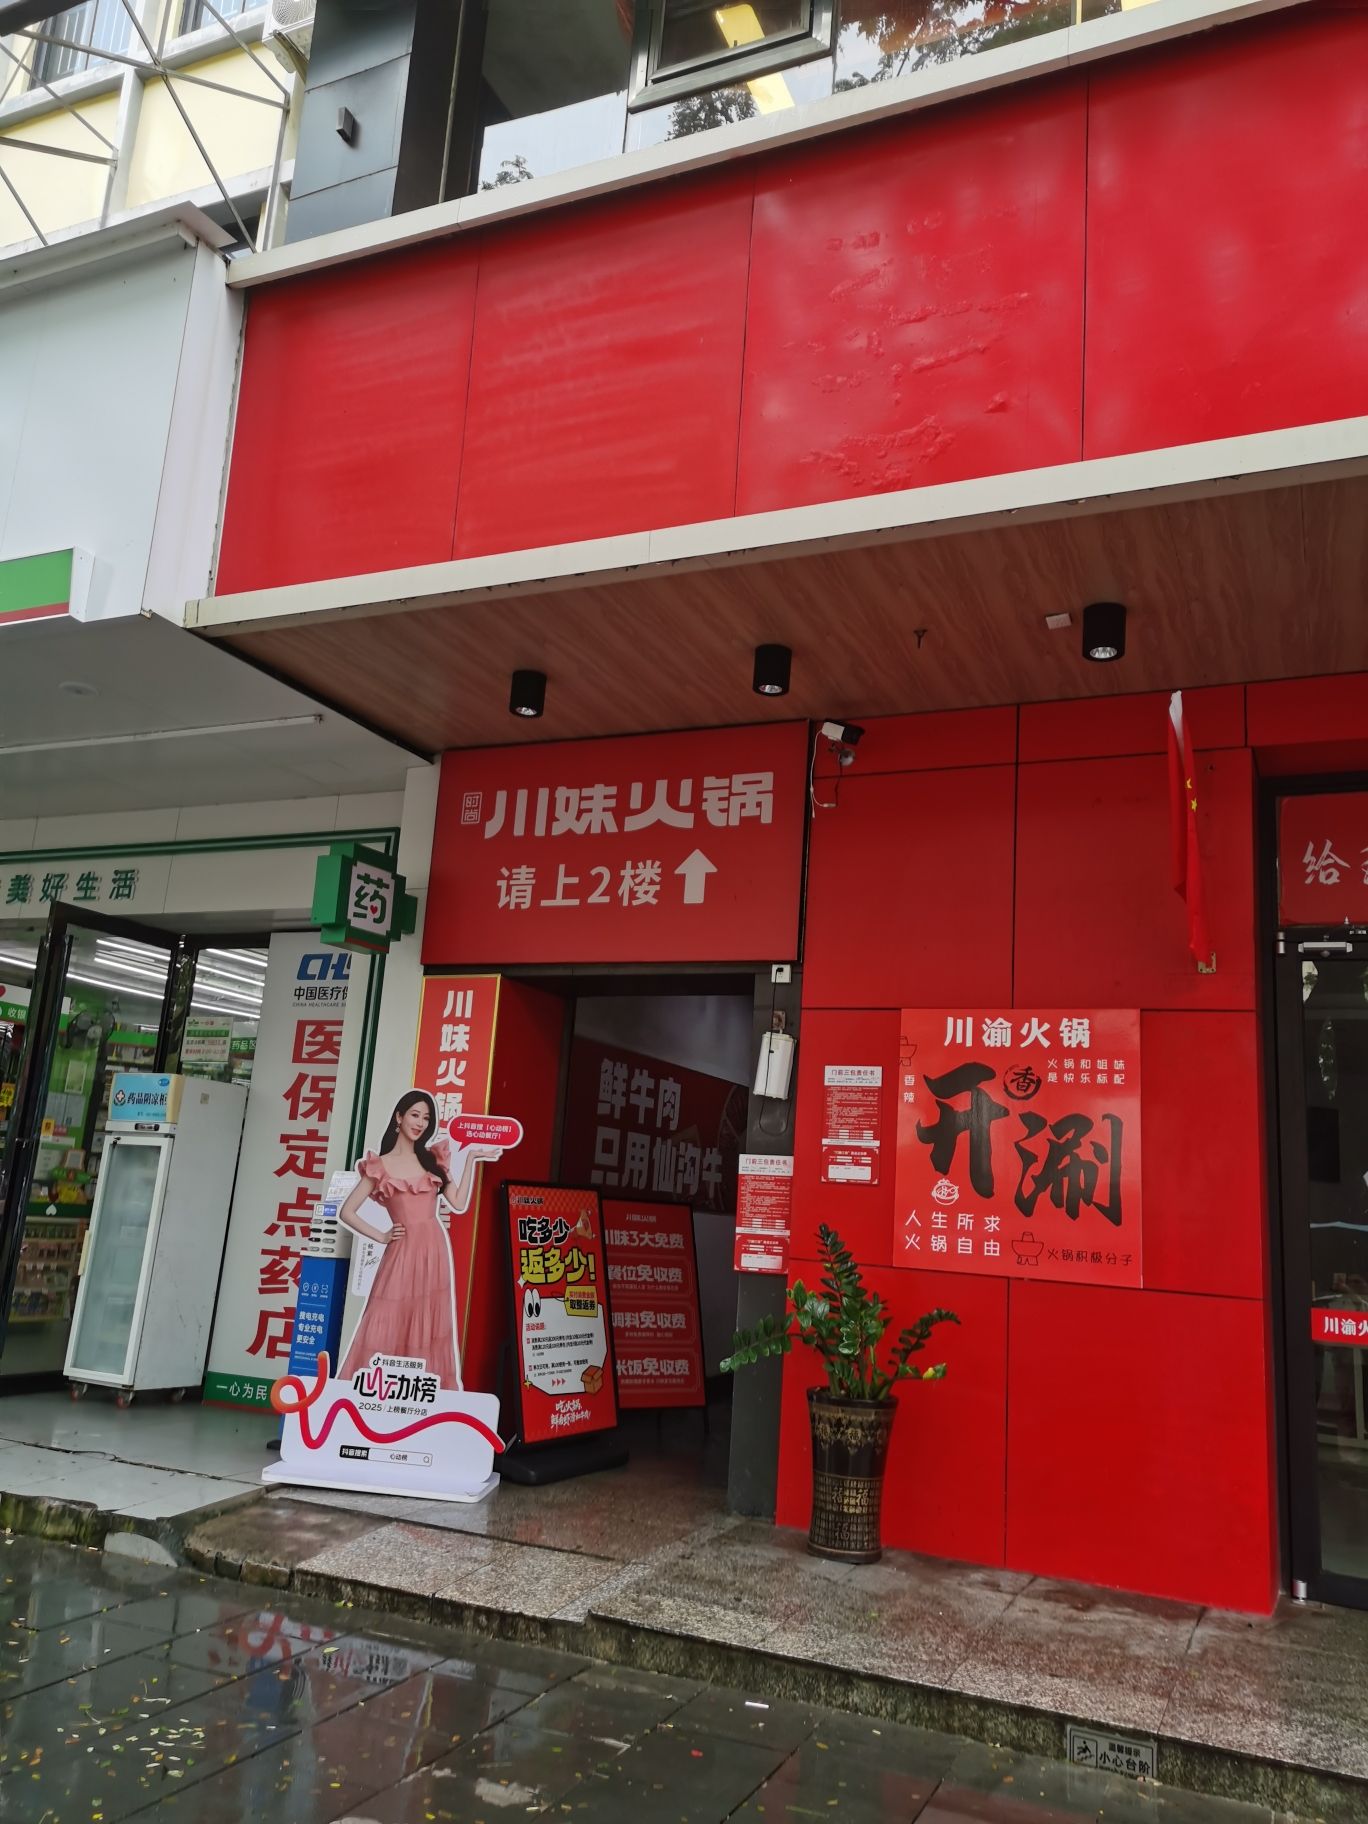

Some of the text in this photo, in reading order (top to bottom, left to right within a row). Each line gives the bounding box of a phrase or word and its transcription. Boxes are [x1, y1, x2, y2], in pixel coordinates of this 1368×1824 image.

[484, 771, 774, 839] 川妹火锅
[6, 868, 137, 904] 美好生活
[352, 873, 391, 924] 药
[496, 860, 662, 910] 请上2楼
[943, 1016, 1090, 1048] 川渝火锅
[1047, 1058, 1126, 1071] 火锅和姐妹
[1047, 1073, 1126, 1085] 是快乐标配
[597, 1057, 682, 1131] 鲜牛肉
[916, 1061, 1123, 1227] 开涮
[591, 1126, 723, 1199] 只用仙沟牛
[246, 1019, 344, 1359] 医保定点药店
[518, 1216, 570, 1245] 吃多少
[905, 1210, 1000, 1232] 人生所求
[905, 1233, 1000, 1256] 火锅自由
[1047, 1248, 1133, 1266] 火锅积极分子
[520, 1247, 596, 1284] 返多少!
[296, 1334, 316, 1345] 更安全
[298, 1323, 323, 1334] 专业充电
[382, 1358, 424, 1370] 抖音生活服务
[216, 1382, 268, 1400] 一心为民
[353, 1369, 438, 1403] 心动榜
[358, 1402, 428, 1416] 2025 上榜餐厅分店
[1100, 1751, 1151, 1775] 小心台阶
